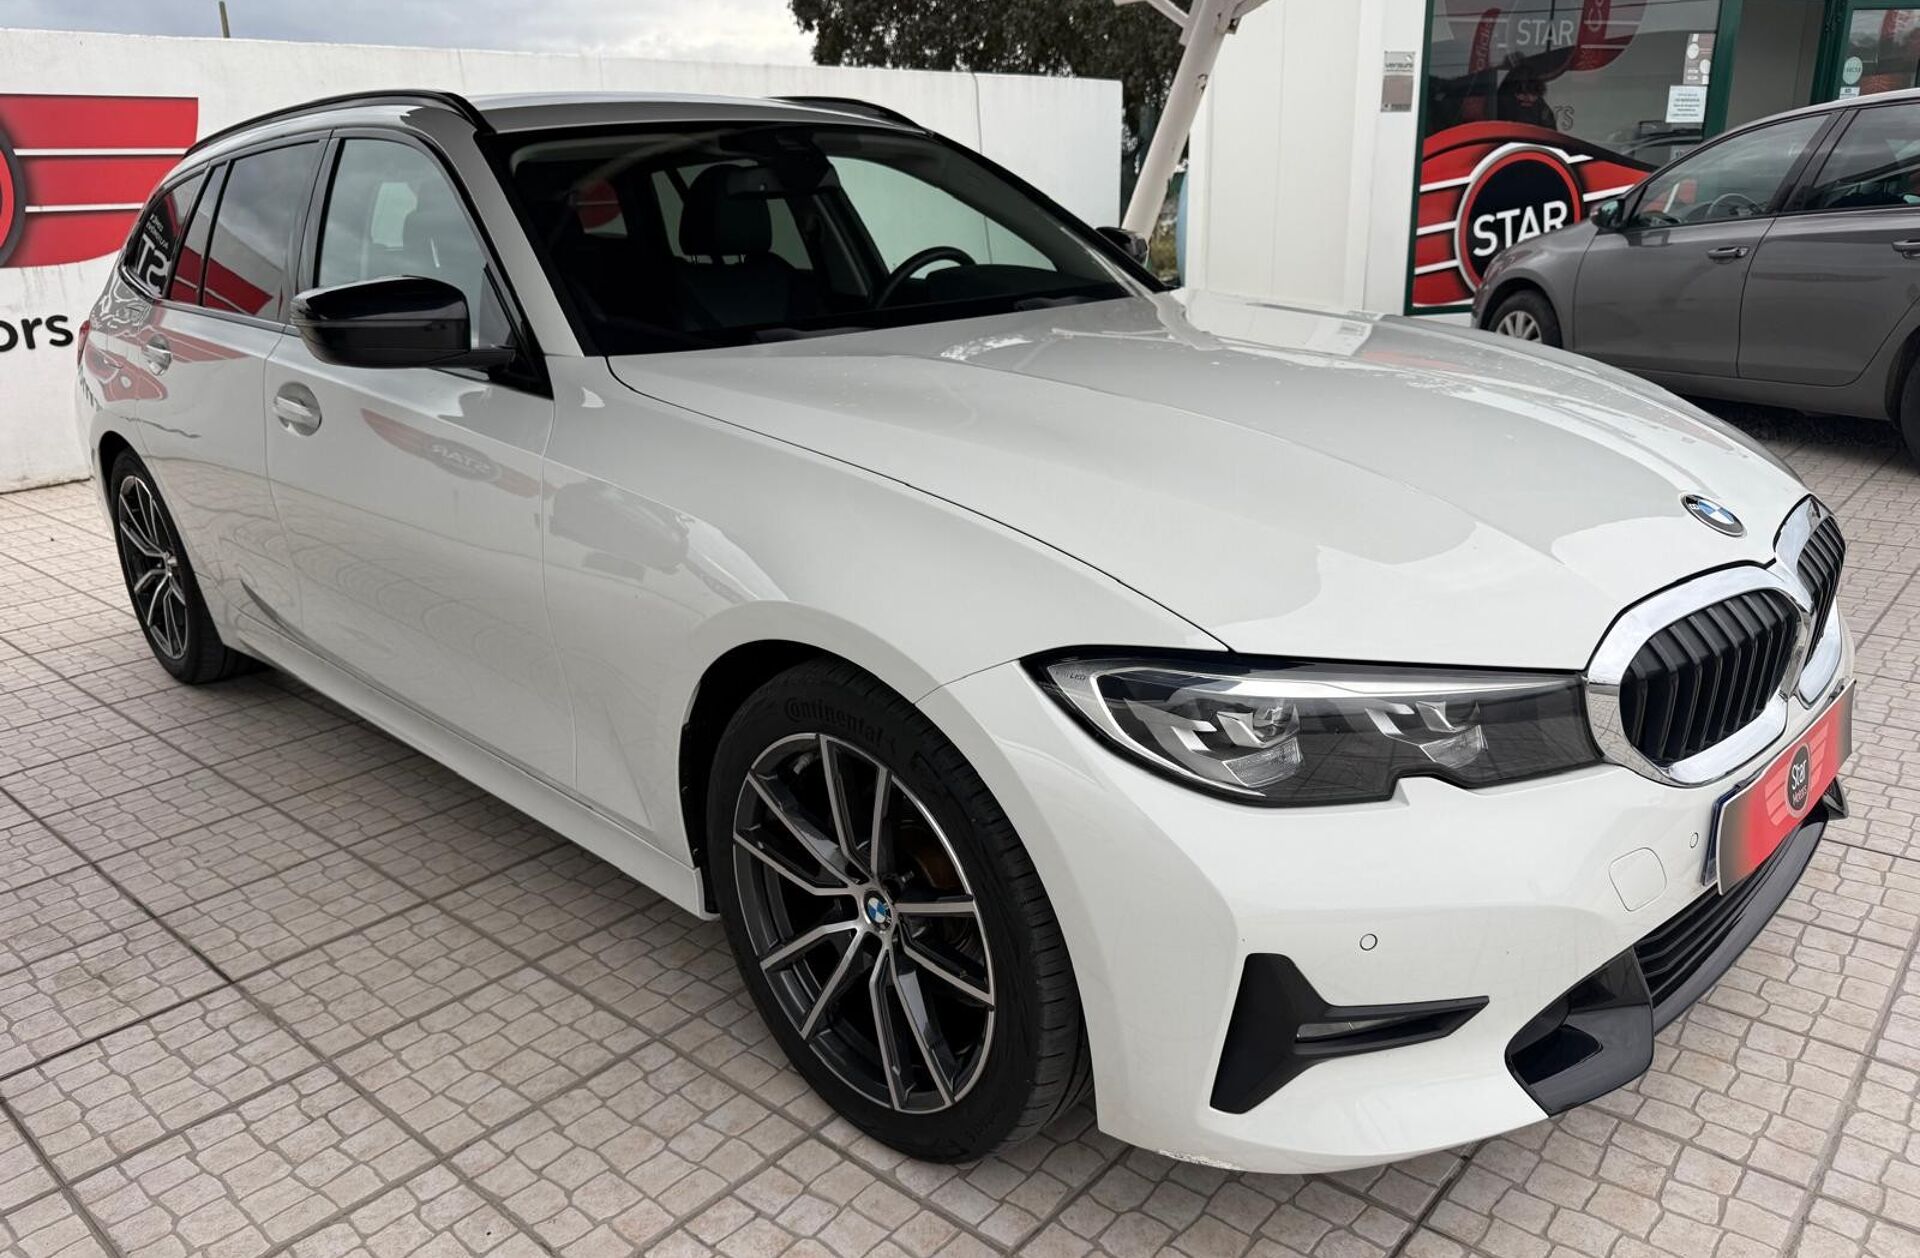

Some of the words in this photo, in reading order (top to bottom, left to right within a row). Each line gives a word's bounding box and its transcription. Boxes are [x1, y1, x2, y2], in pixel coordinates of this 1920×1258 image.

[1516, 19, 1575, 46] STAR
[1473, 200, 1568, 256] STAR
[784, 697, 885, 742] Continental
